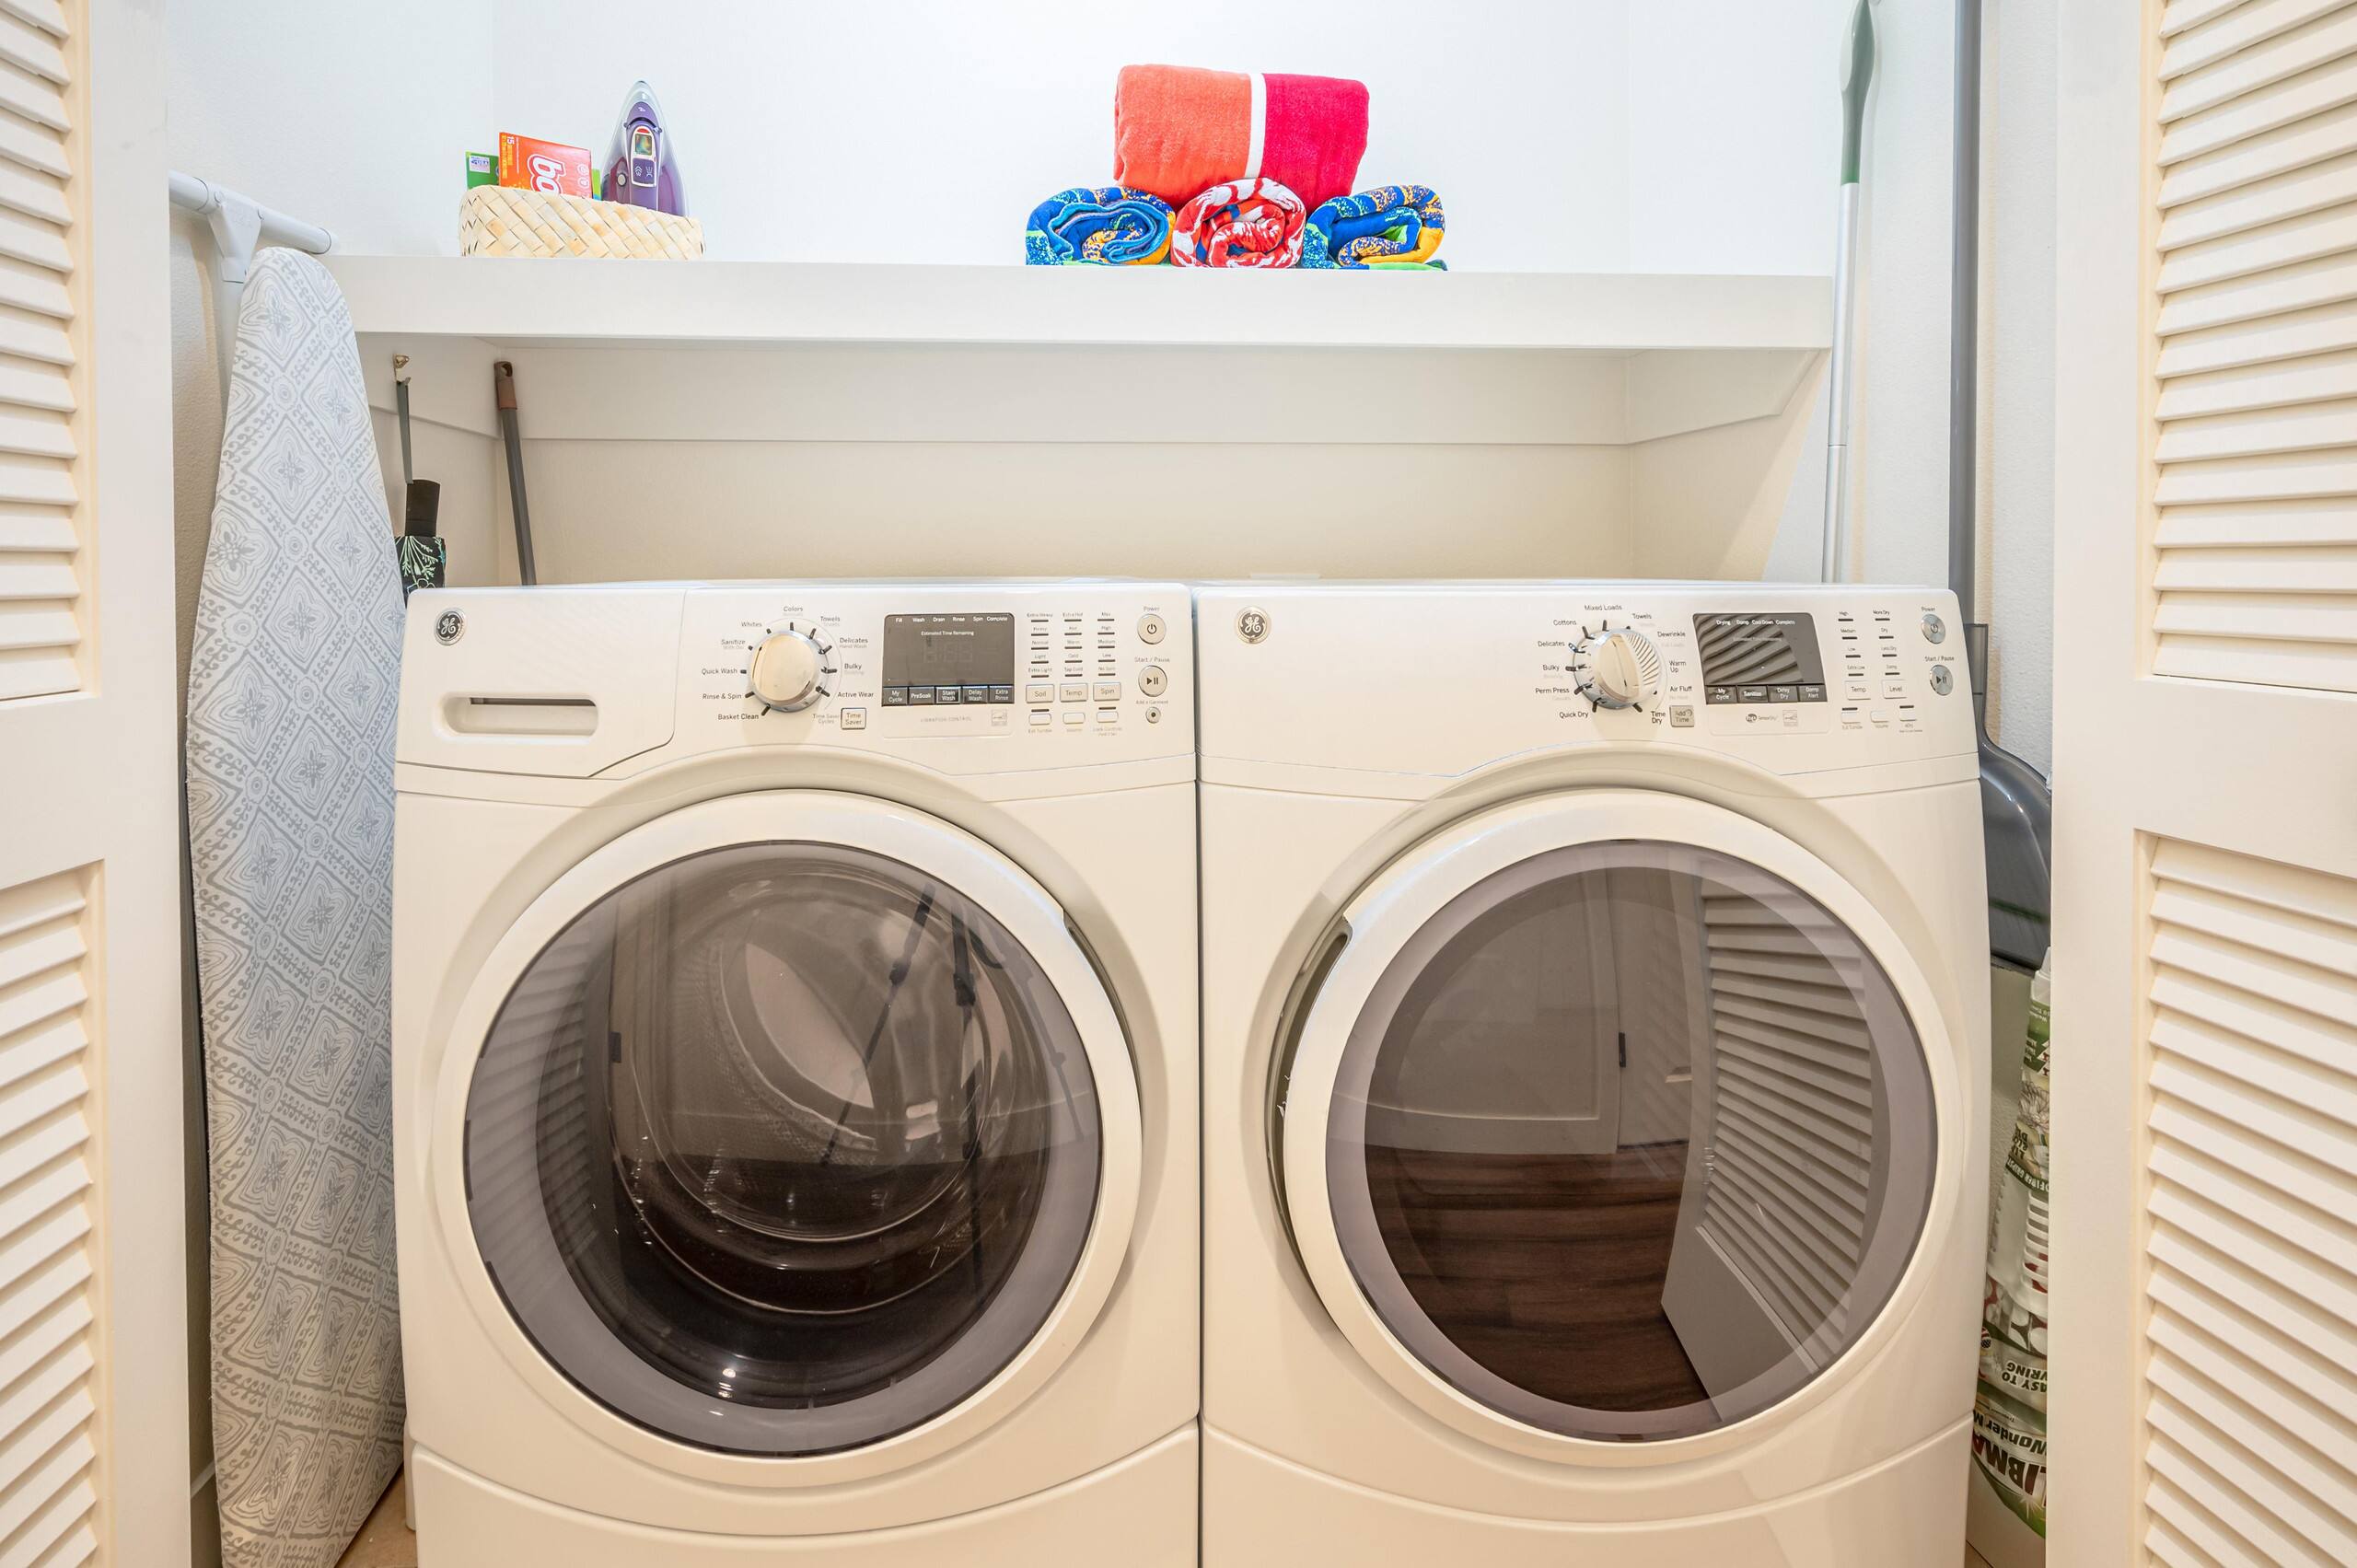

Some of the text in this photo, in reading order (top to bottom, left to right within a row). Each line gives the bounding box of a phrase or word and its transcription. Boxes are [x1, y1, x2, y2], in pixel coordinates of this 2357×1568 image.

[506, 136, 515, 145] 15
[2003, 1372, 2048, 1392] ASY TO
